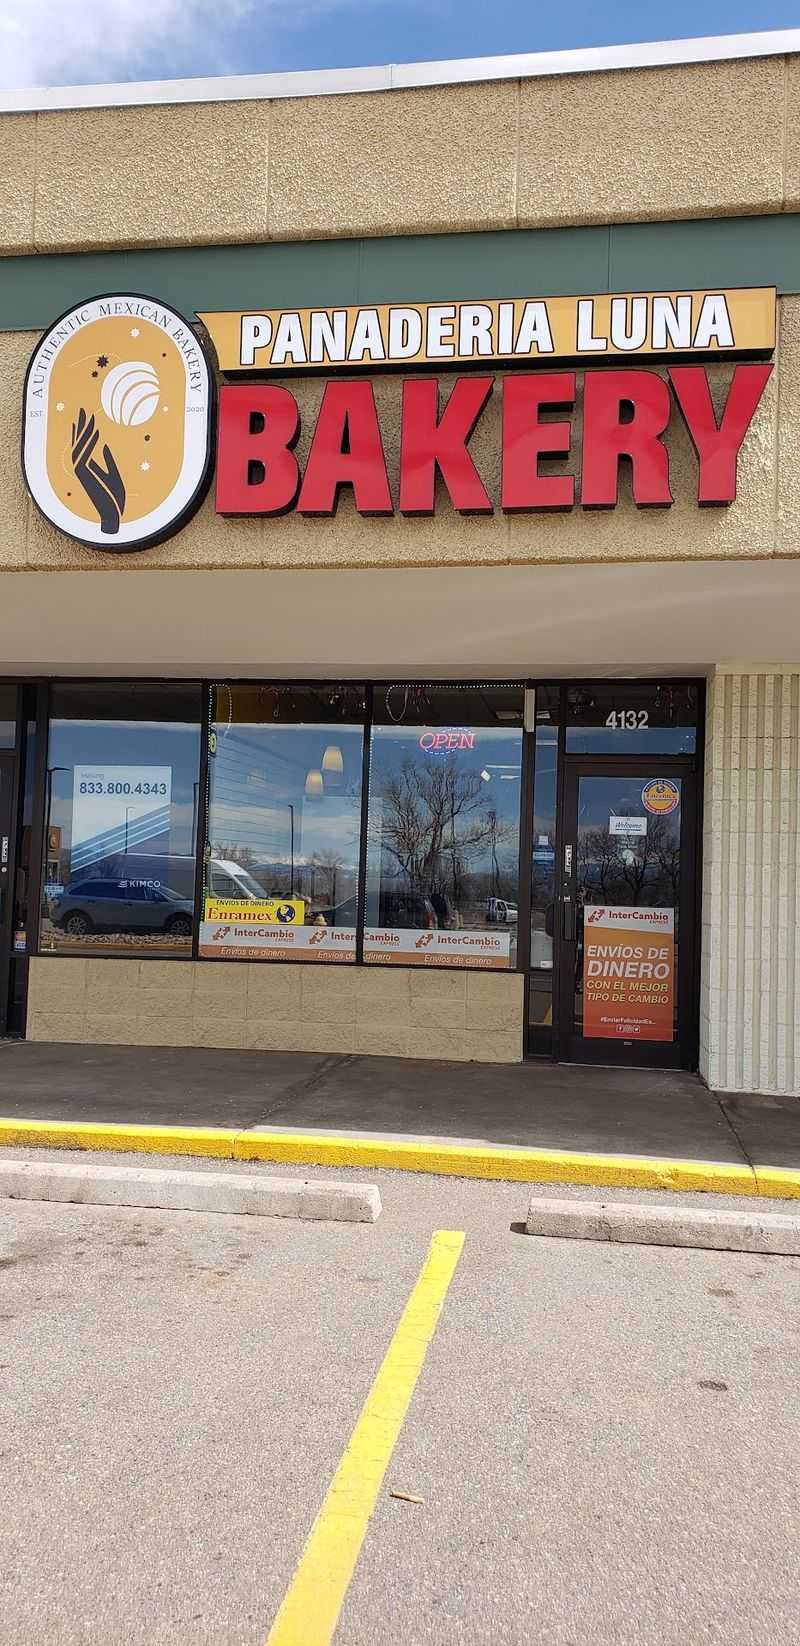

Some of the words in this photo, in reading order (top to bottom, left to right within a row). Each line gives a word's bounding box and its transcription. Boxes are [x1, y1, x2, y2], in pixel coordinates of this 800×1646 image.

[240, 301, 555, 366] PANADERIA
[576, 294, 736, 352] LUNA
[32, 310, 90, 398] AUTHENTIC
[99, 302, 172, 328] MEXICAN
[172, 328, 202, 393] BAKERY
[215, 364, 775, 516] BAKERY
[605, 710, 649, 730] 4132
[419, 731, 477, 750] OPEN
[79, 782, 167, 795] 833.800.4343
[129, 879, 161, 889] KIMCO
[207, 907, 272, 921] Enramex
[608, 911, 669, 921] InterCambio
[234, 927, 295, 939] InterCambio
[437, 935, 501, 947] InterCambio
[260, 949, 286, 957] dinero
[587, 943, 643, 959] ENVÍOS
[647, 947, 669, 960] DE
[452, 955, 463, 964] de
[465, 956, 492, 965] dinero
[587, 960, 670, 979] DINERO
[586, 980, 611, 990] CON
[613, 981, 627, 991] EL
[629, 982, 669, 993] MEJOR
[587, 992, 610, 1001] TIPO
[611, 993, 626, 1002] DE
[628, 994, 669, 1004] CAMBIO
